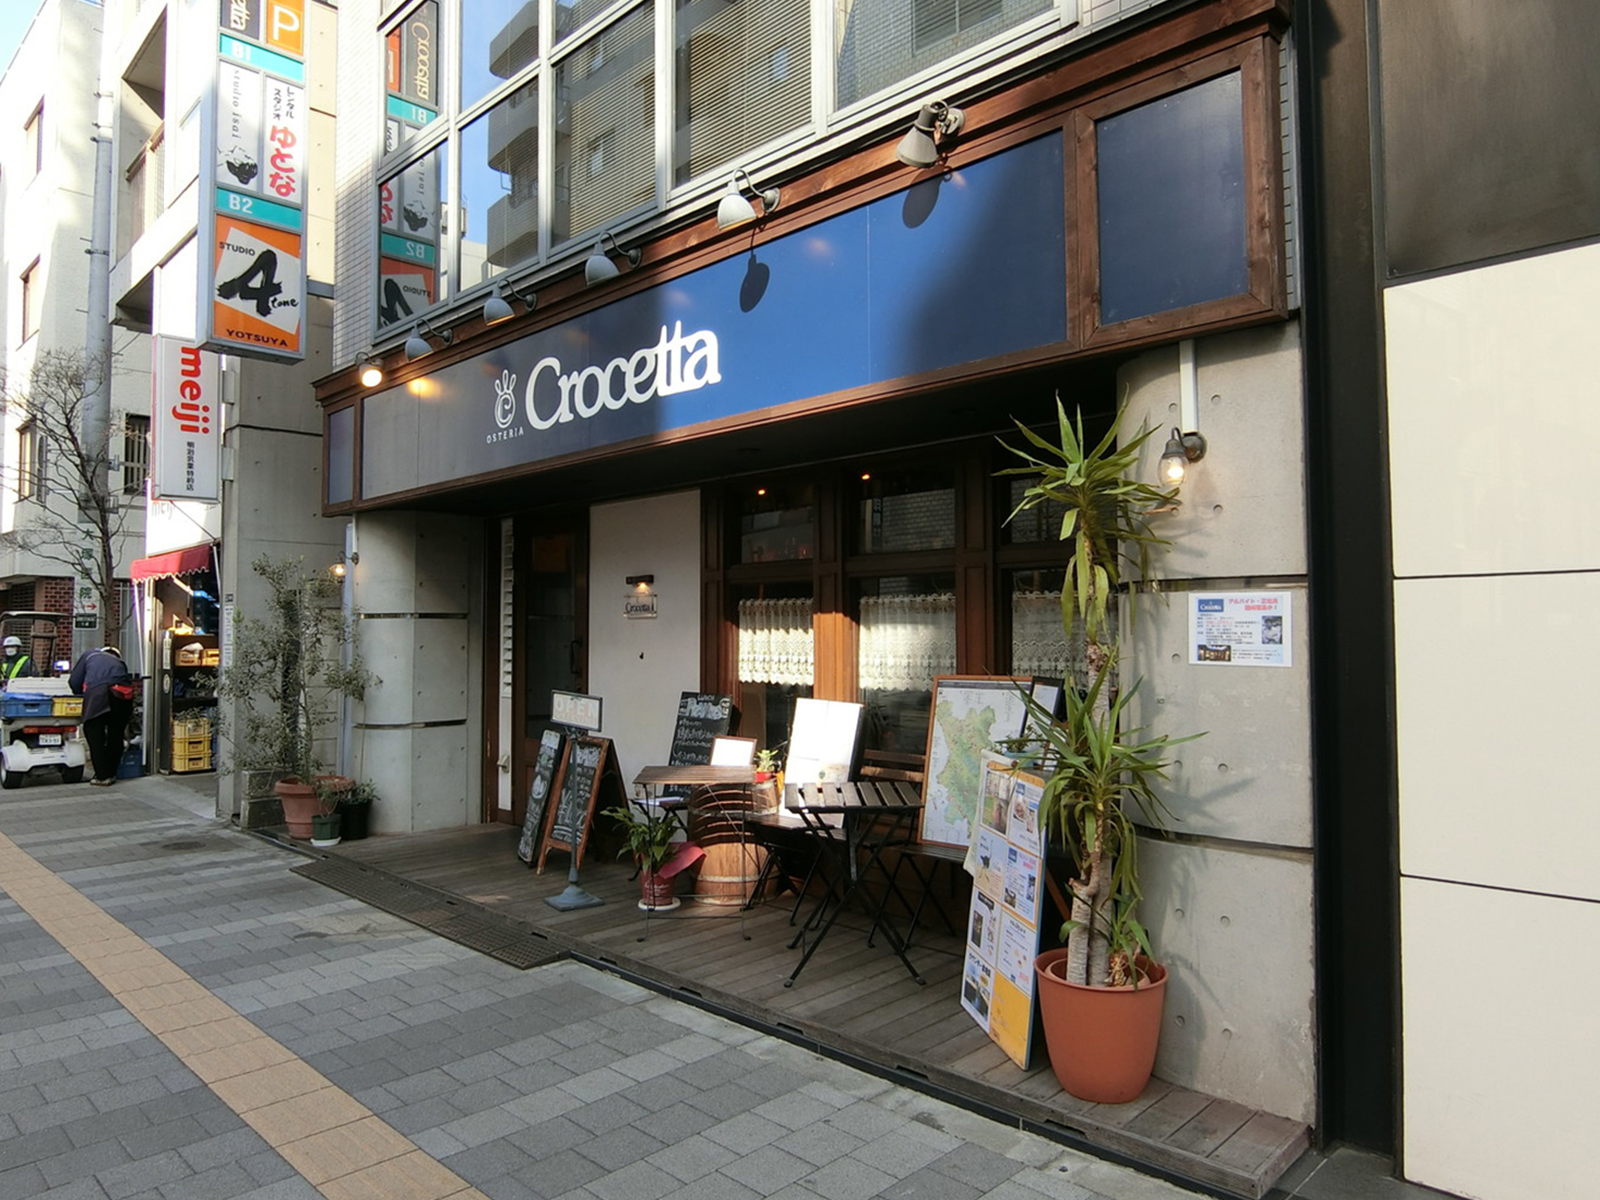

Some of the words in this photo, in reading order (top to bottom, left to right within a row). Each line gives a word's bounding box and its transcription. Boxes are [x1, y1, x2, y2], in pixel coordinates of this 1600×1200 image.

[273, 5, 300, 41] P
[231, 40, 252, 63] B1
[273, 88, 282, 120] スタジオ
[286, 86, 295, 119] レンタル
[269, 125, 297, 197] ゆとな
[229, 194, 253, 214] B2
[219, 242, 256, 256] STUDIO
[226, 328, 289, 347] YOTSUYA
[172, 346, 210, 434] meiji
[525, 320, 721, 430] Crocetta
[486, 427, 524, 444] OSTERIA
